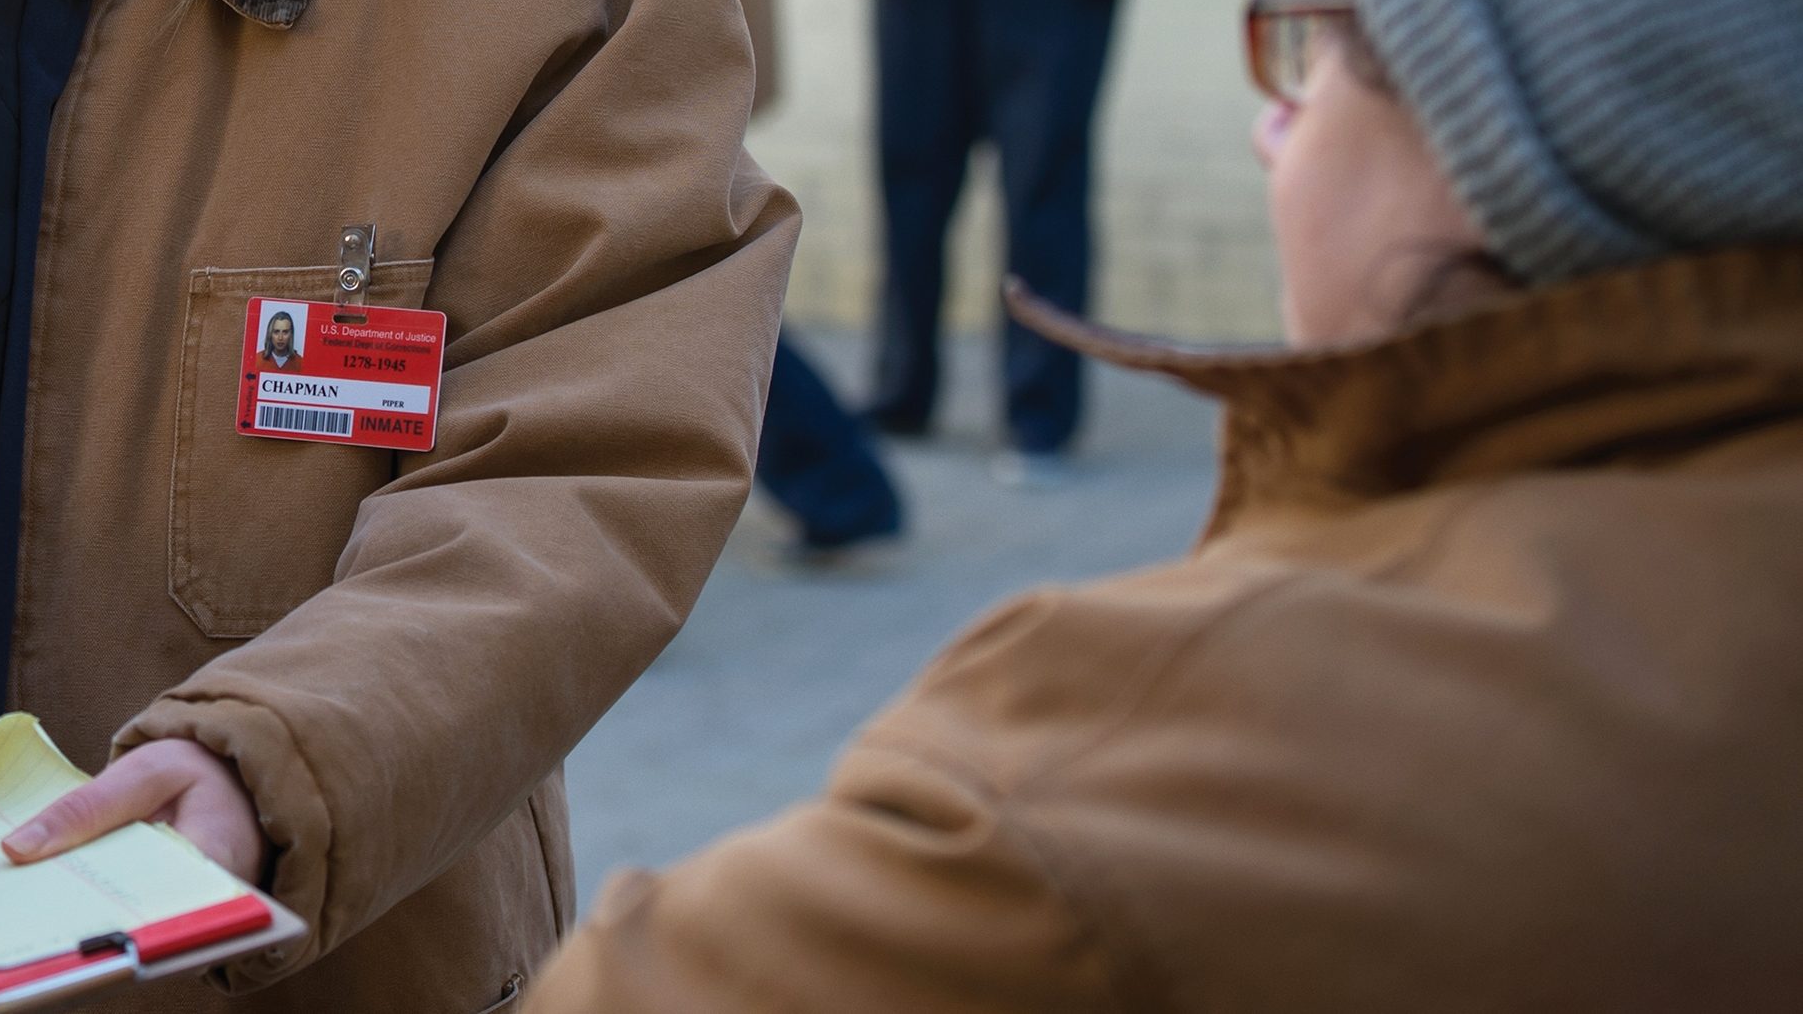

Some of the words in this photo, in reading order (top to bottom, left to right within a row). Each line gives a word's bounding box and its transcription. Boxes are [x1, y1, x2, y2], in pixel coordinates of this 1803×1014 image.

[320, 324, 340, 335] U.S.
[341, 326, 393, 340] Department
[394, 331, 404, 340] of
[405, 332, 436, 343] Justice
[343, 355, 406, 372] 1278-1945
[262, 379, 339, 398] CHAPMAN
[382, 399, 405, 408] PIPER
[360, 416, 424, 436] INMATE
